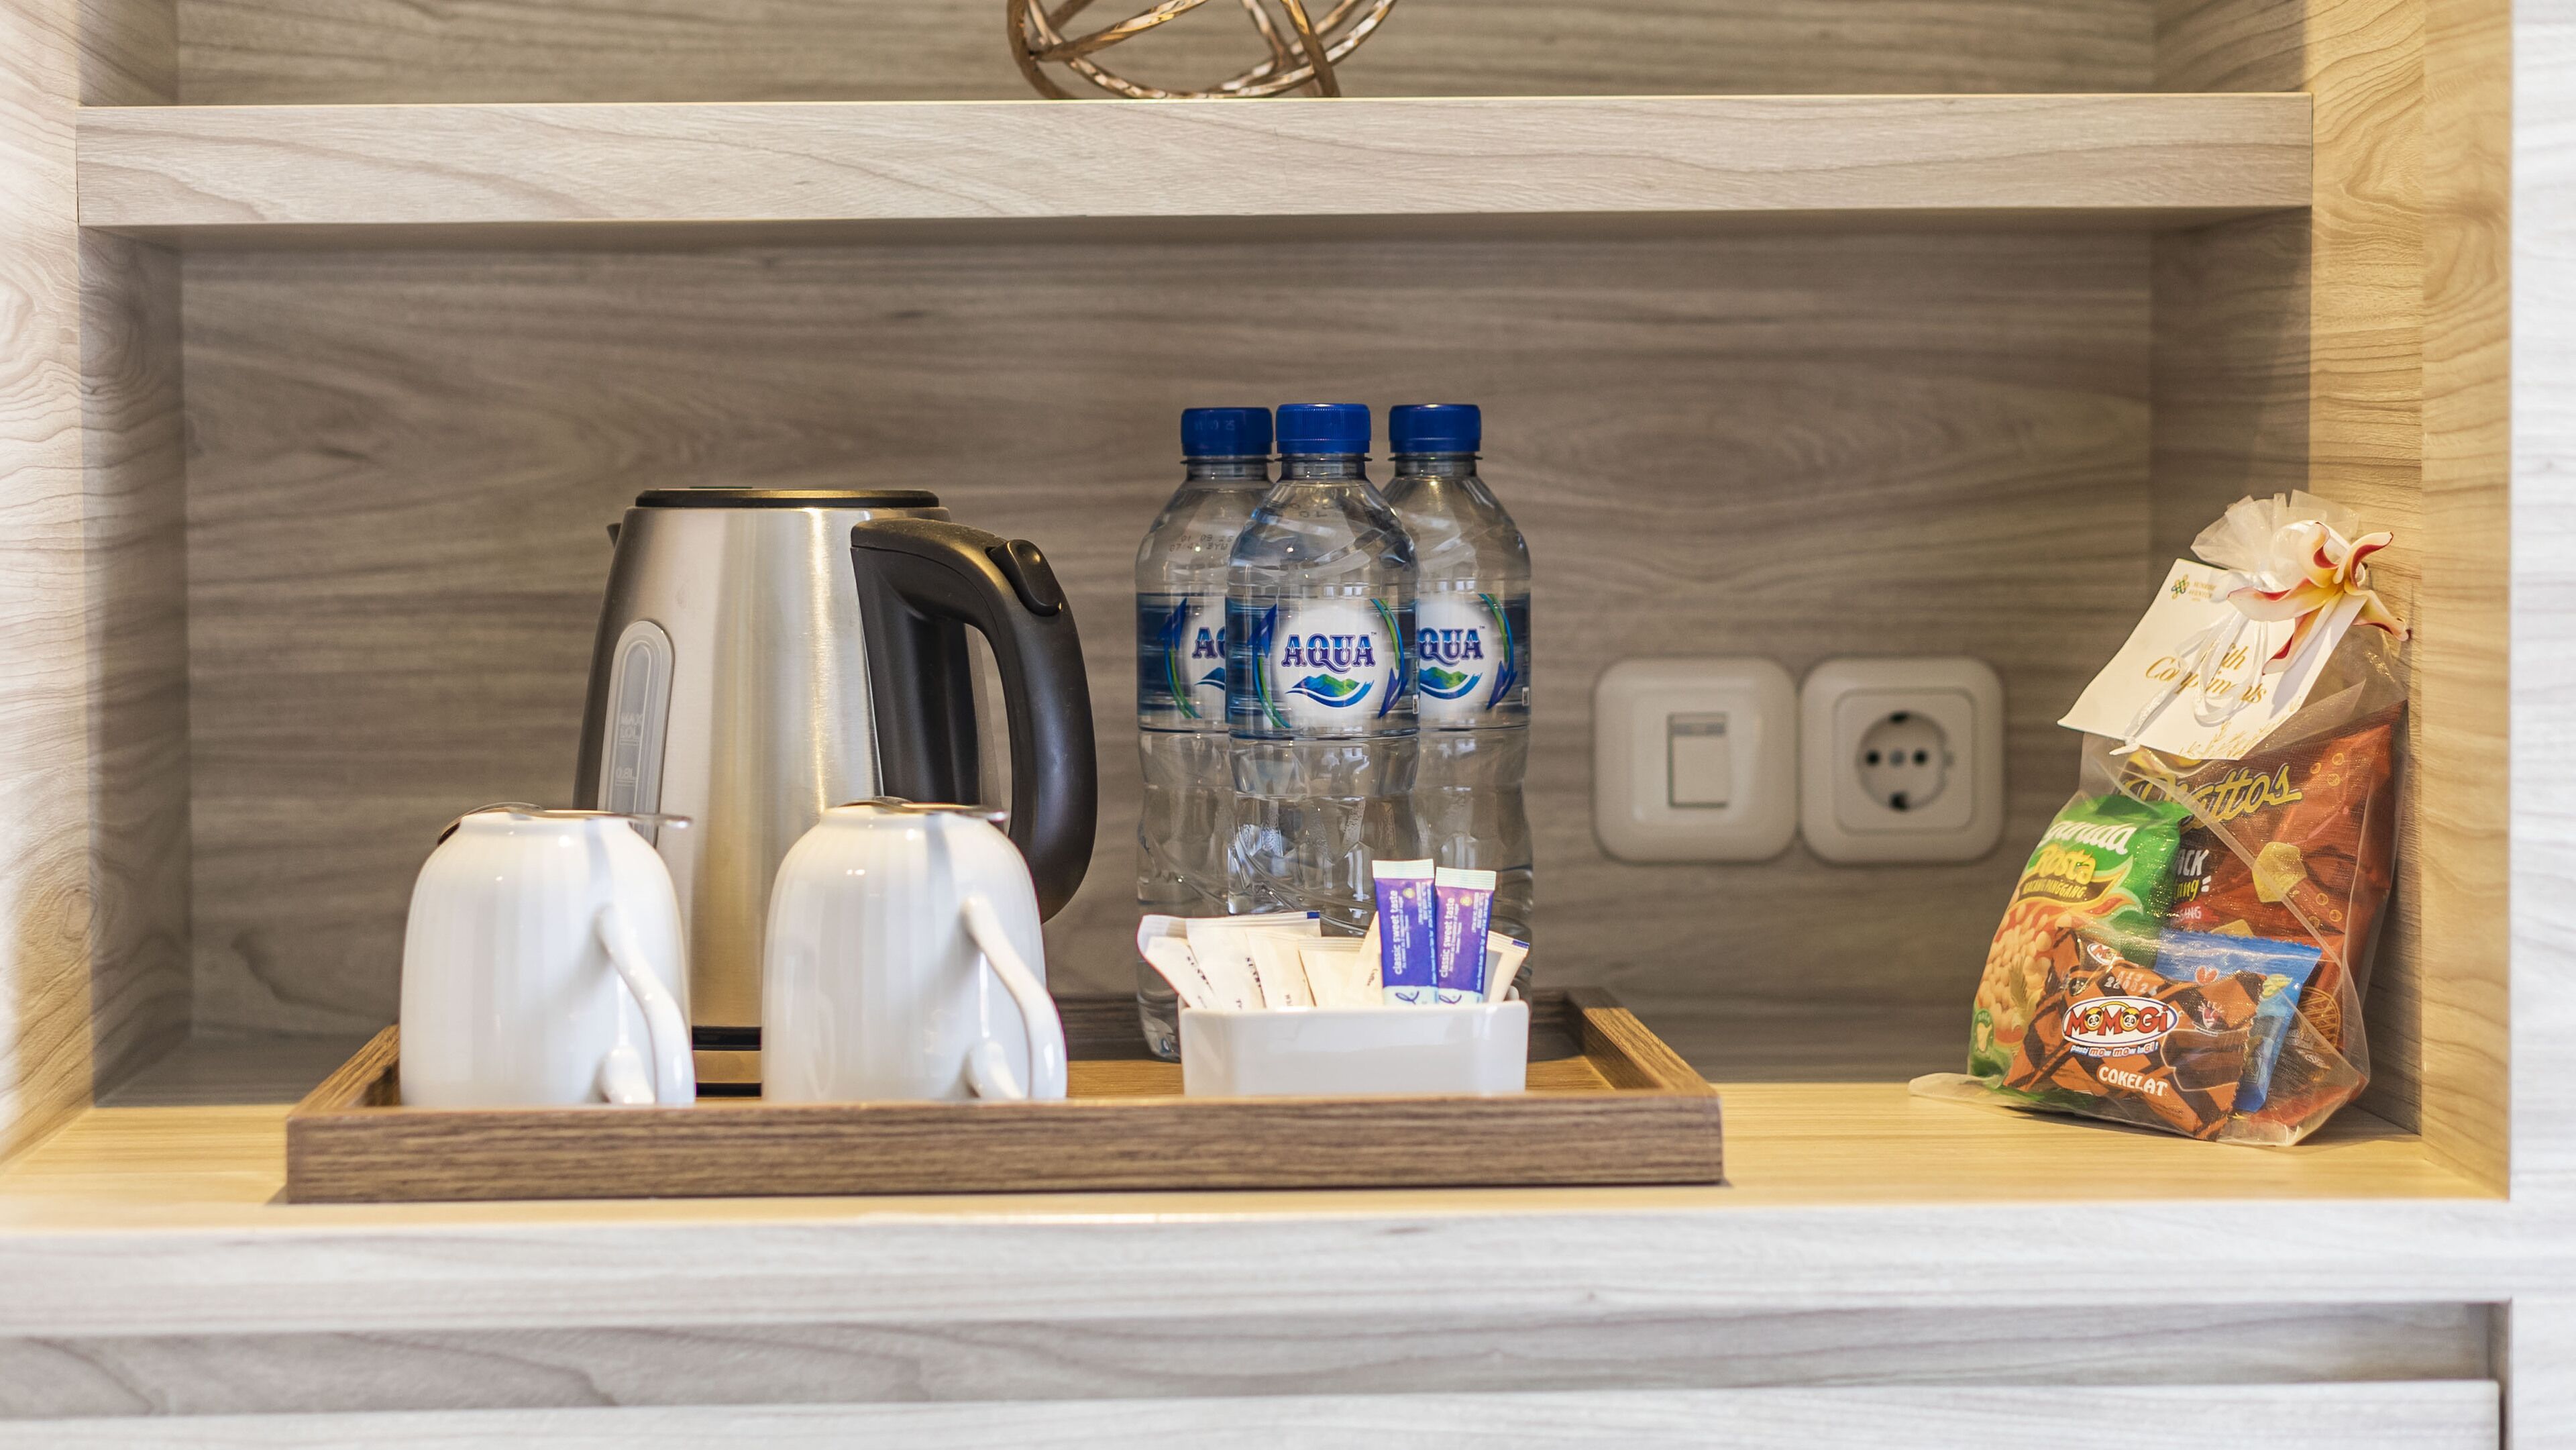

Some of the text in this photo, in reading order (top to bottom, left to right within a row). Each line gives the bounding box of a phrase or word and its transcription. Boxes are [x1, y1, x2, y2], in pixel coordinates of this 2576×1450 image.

[1281, 633, 1376, 673] AQUA
[2033, 843, 2096, 885] Rosta
[1389, 890, 1399, 913] taste
[2046, 878, 2088, 898] PANGGANG
[1444, 897, 1455, 920] taste
[1390, 914, 1400, 943] sweet
[1443, 920, 1453, 947] sweet
[1391, 944, 1403, 975] classic
[1438, 948, 1450, 978] classic
[2098, 1066, 2169, 1097] COKELAT
